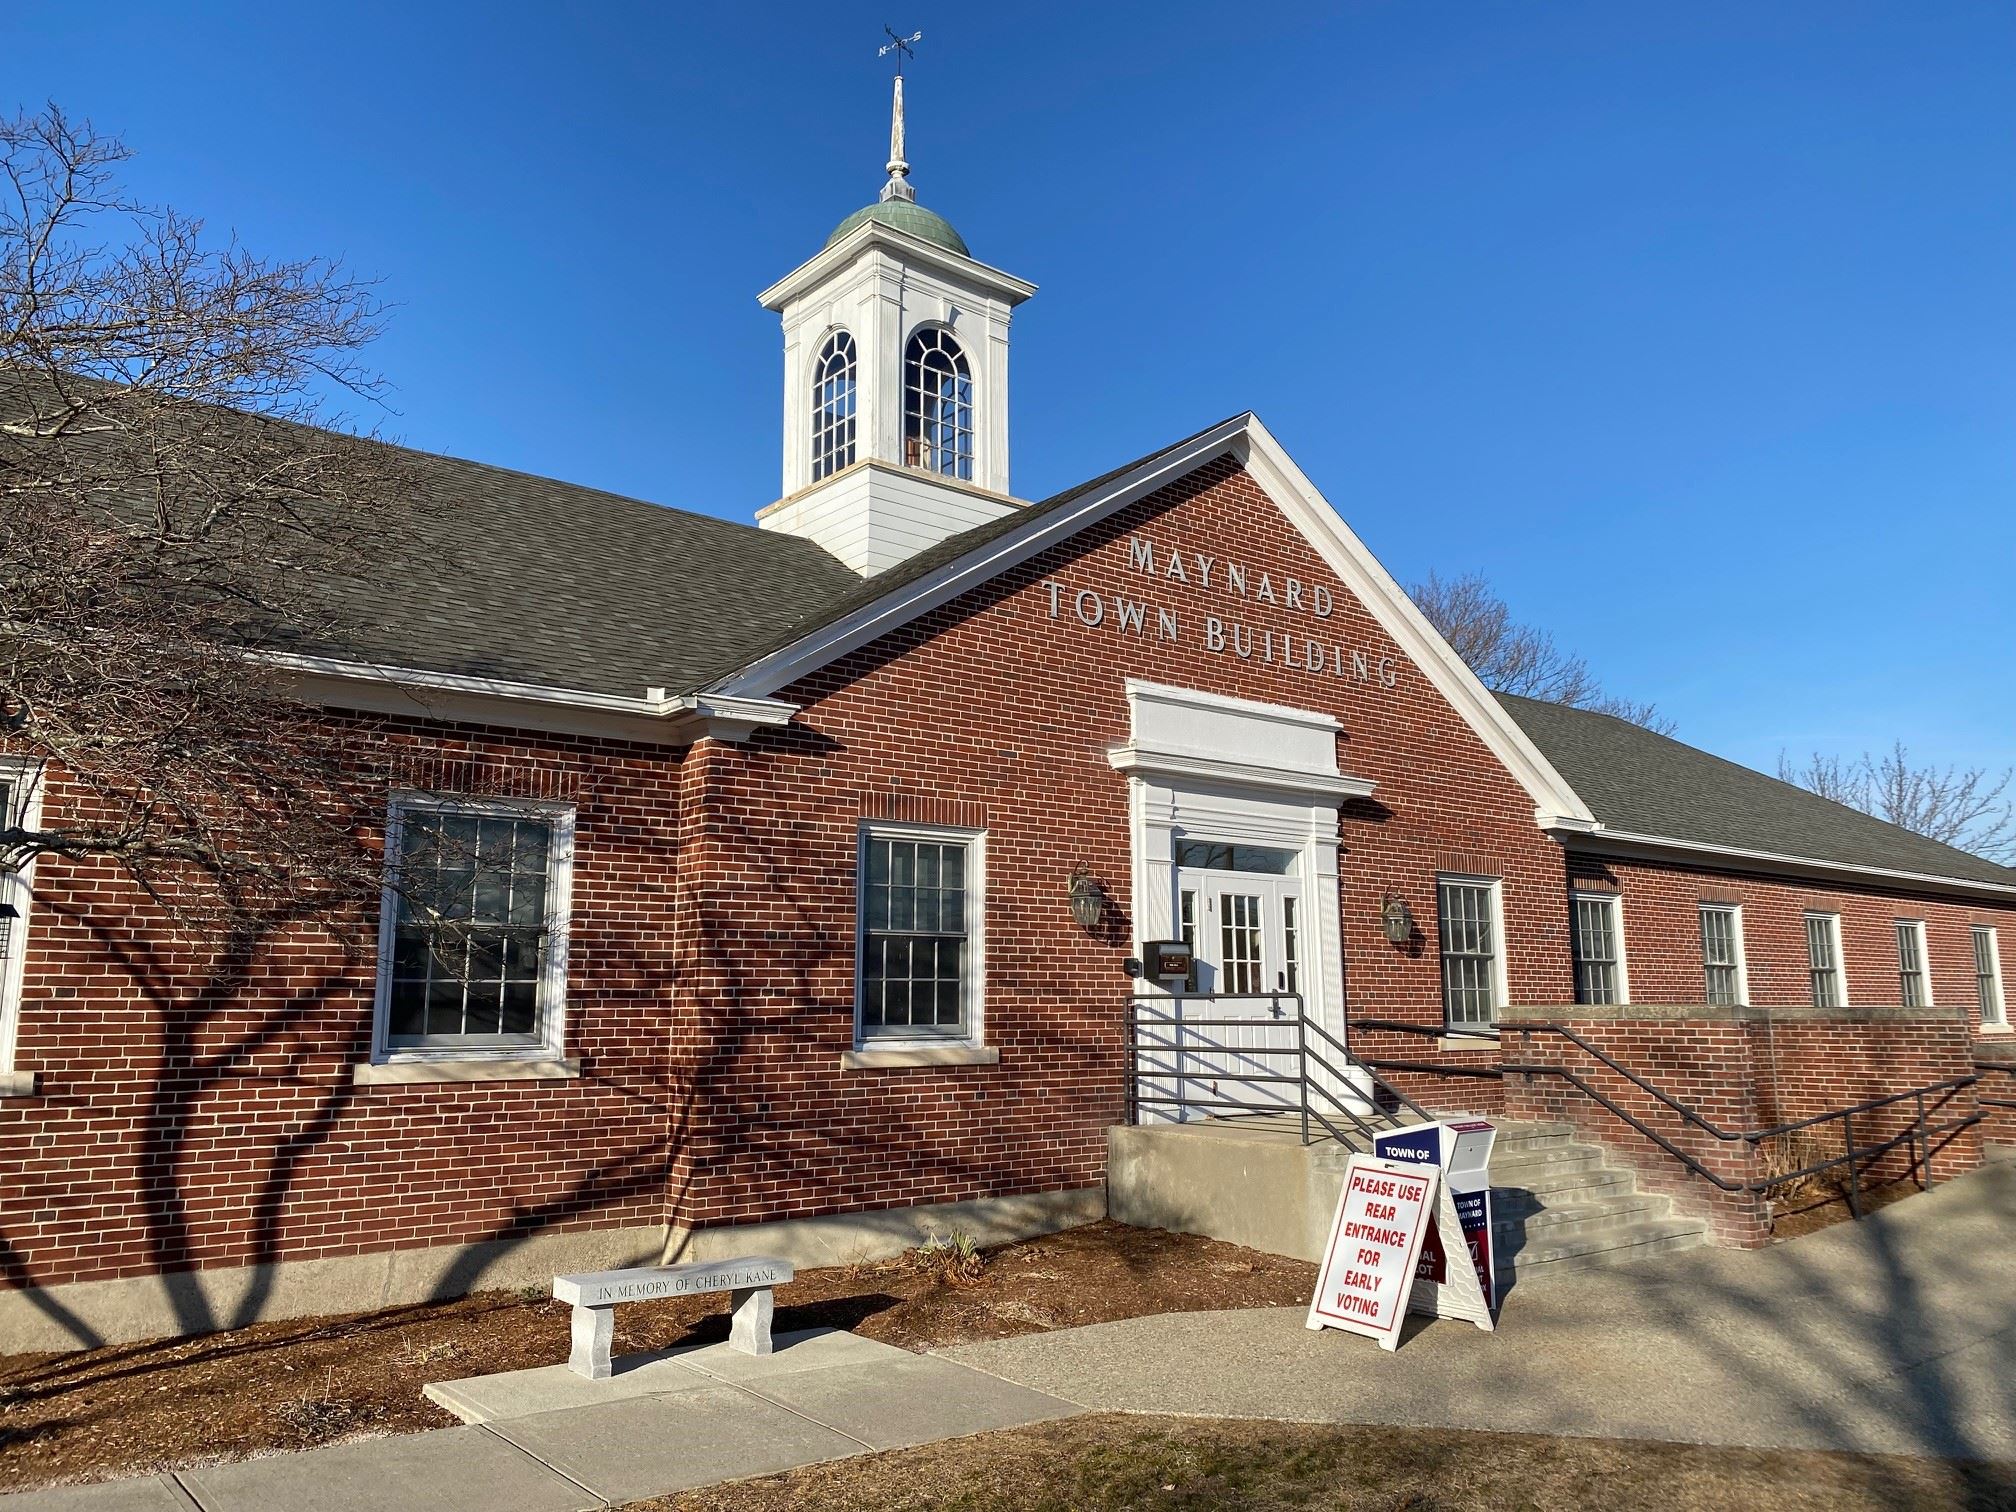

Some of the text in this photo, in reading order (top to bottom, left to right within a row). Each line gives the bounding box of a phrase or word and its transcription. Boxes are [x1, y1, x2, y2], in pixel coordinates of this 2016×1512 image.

[1128, 536, 1333, 618] MAYNARD
[1042, 580, 1396, 687] TOWN BUILDING
[1385, 1146, 1430, 1160] TOWN OF
[1352, 1176, 1422, 1202] PLEASE USE
[1365, 1202, 1396, 1222] REAR
[1456, 1198, 1481, 1210] TOWN OF
[1344, 1221, 1406, 1248] ENTRANCE
[1357, 1248, 1380, 1267] FOR
[599, 1269, 777, 1300] IN MEMORY OF CHERYL KANE
[1344, 1270, 1383, 1292] EARLY
[1337, 1292, 1379, 1317] VOTING
